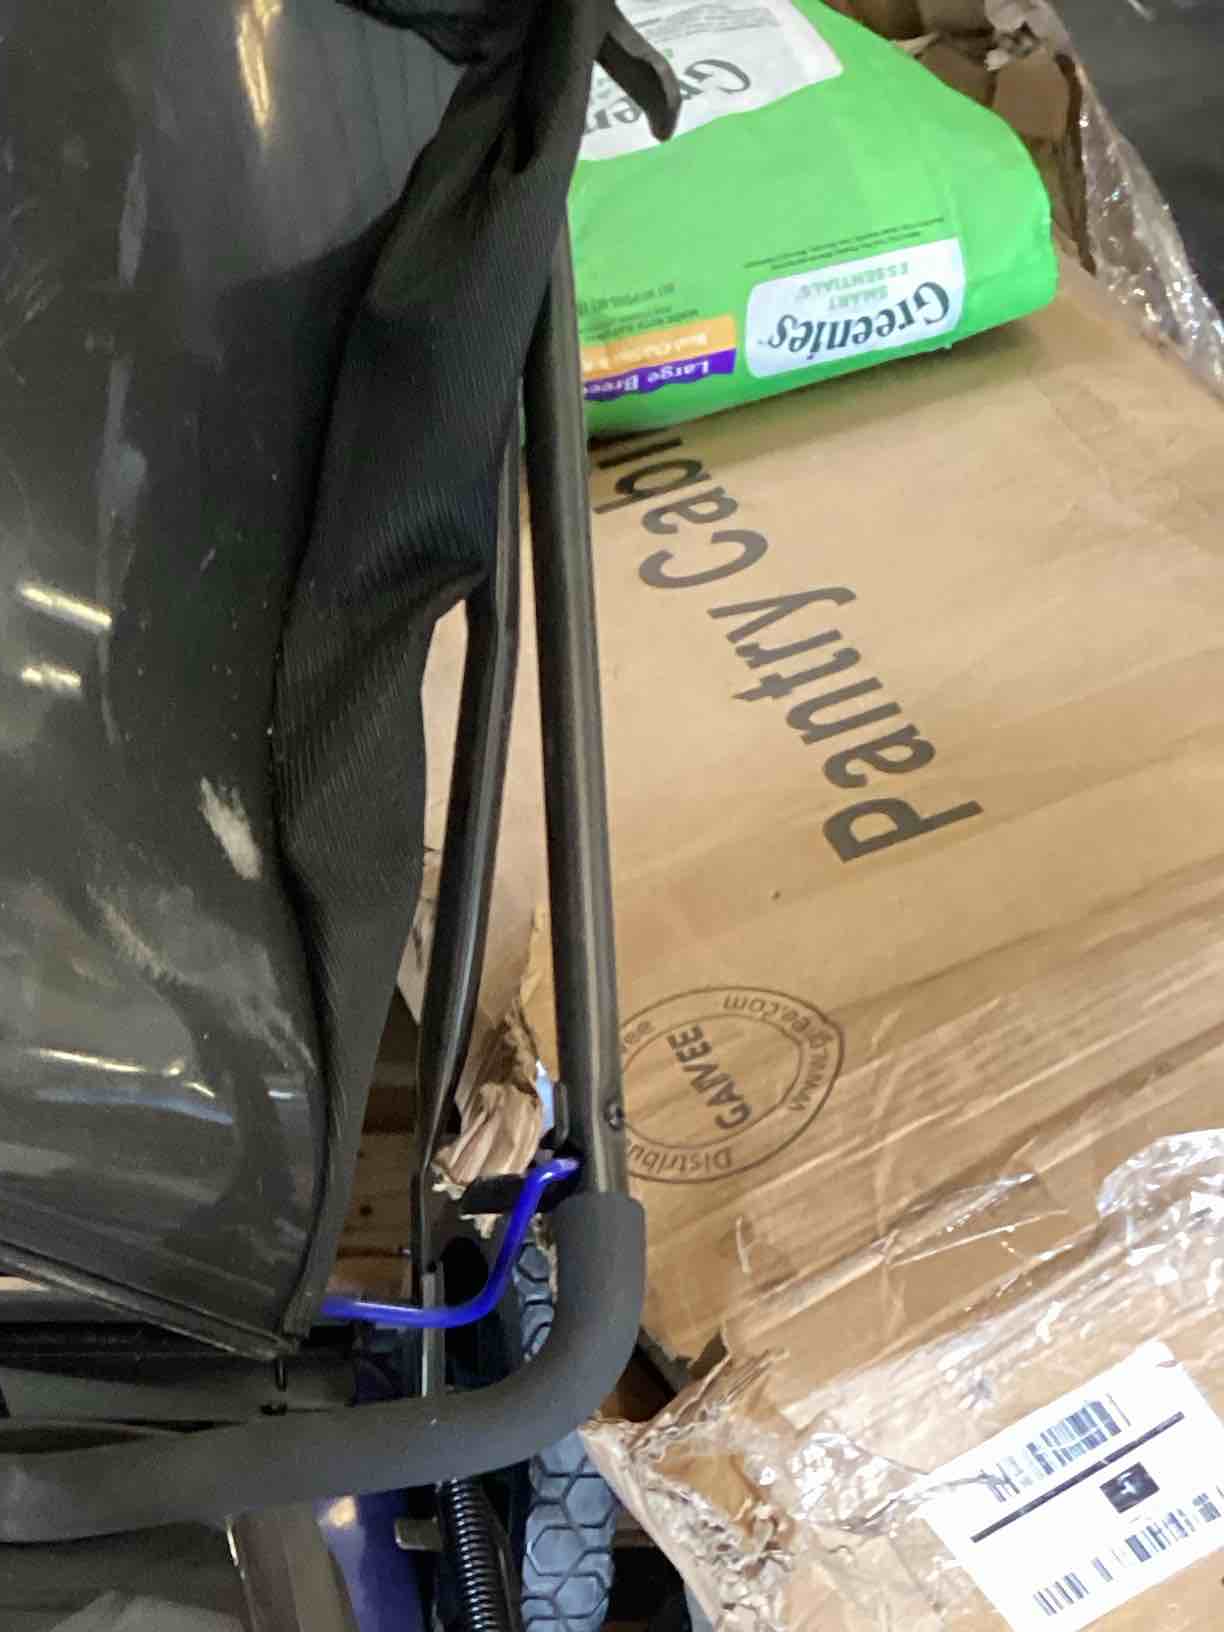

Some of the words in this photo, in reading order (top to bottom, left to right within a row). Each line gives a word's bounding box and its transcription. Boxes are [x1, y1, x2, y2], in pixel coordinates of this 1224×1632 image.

[768, 280, 951, 360] Greenies
[647, 358, 711, 386] Large
[592, 434, 769, 589] Cabi
[707, 585, 984, 864] Pantry
[624, 1141, 733, 1175] Distribu
